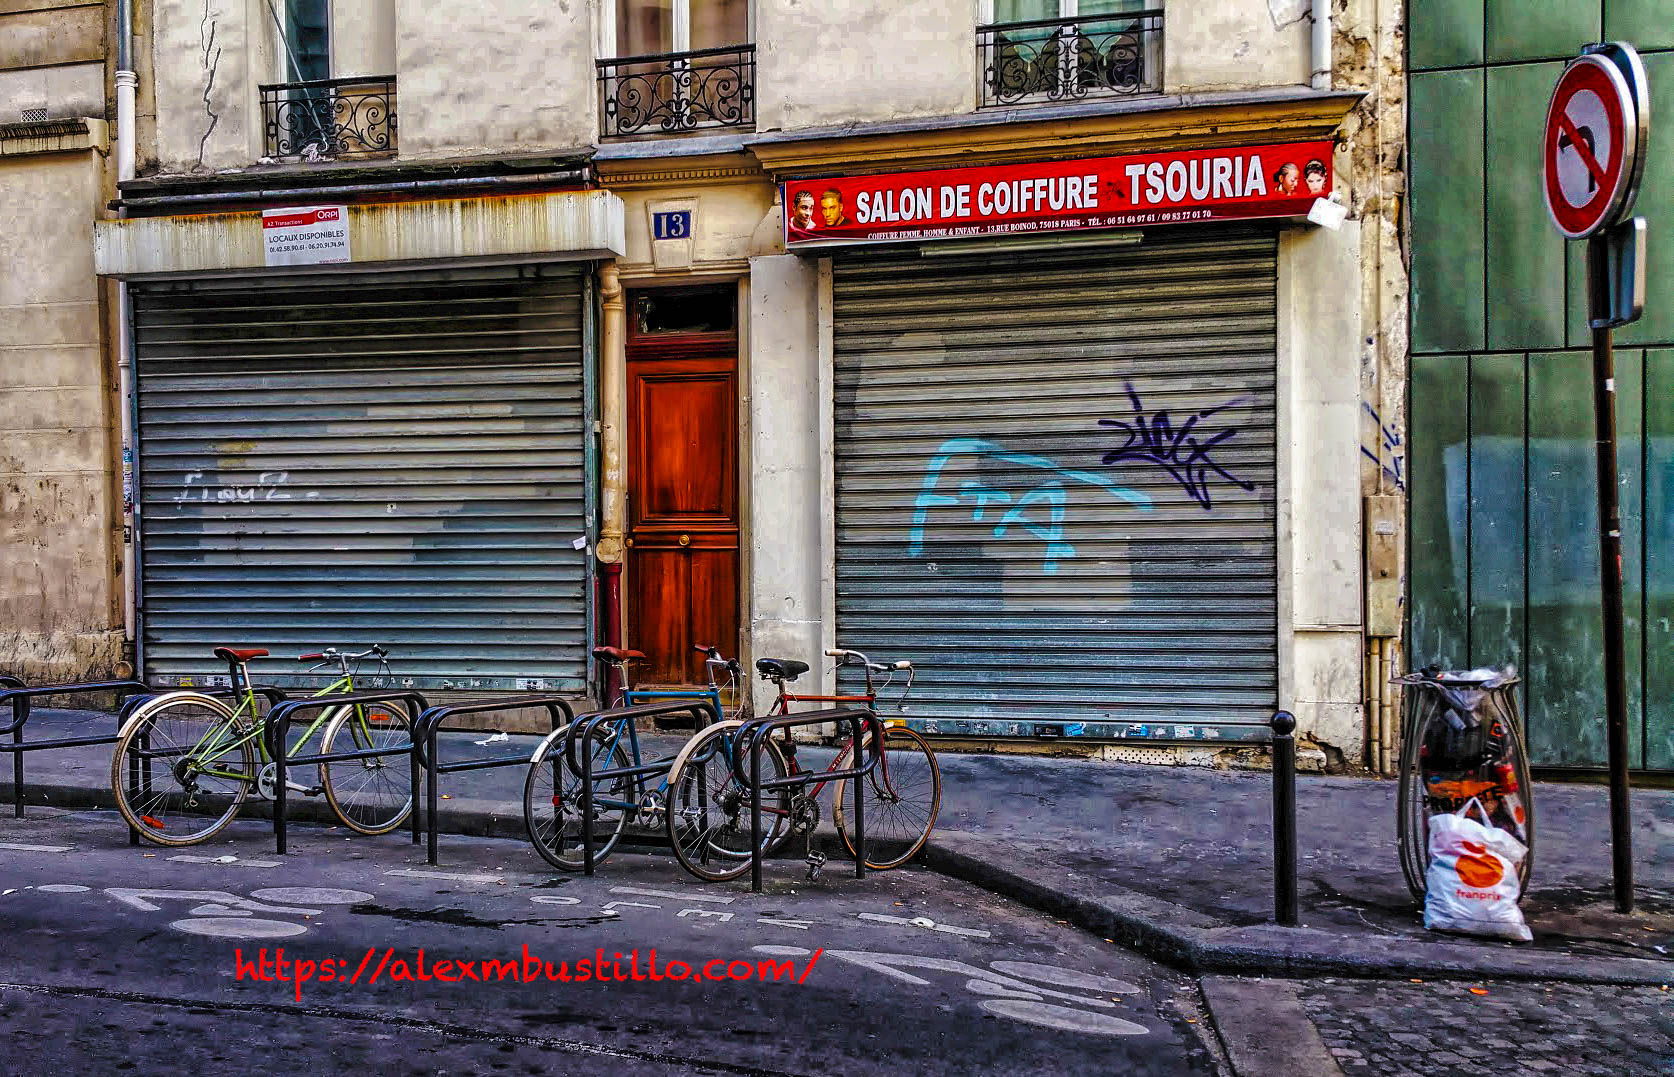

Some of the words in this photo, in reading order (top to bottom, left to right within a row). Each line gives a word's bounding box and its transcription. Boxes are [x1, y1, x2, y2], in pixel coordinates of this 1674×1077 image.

[856, 187, 933, 224] SALON
[940, 184, 971, 219] DE
[977, 174, 1098, 216] COIFFURE
[1125, 155, 1267, 204] TSOURIA
[317, 210, 338, 219] ORPI
[660, 213, 685, 238] 13
[923, 228, 947, 238] HOMME
[954, 226, 980, 236] ENFANT
[1039, 220, 1060, 229] 75018
[1060, 219, 1081, 228] PARIS
[1107, 216, 1116, 225] 06
[1117, 215, 1125, 225] 51
[1146, 213, 1155, 222] 61
[1182, 211, 1191, 220] 77
[1191, 210, 1201, 219] 01
[1202, 209, 1212, 218] 70
[269, 234, 298, 243] LOCAUX
[300, 230, 344, 240] DISPONIBLES
